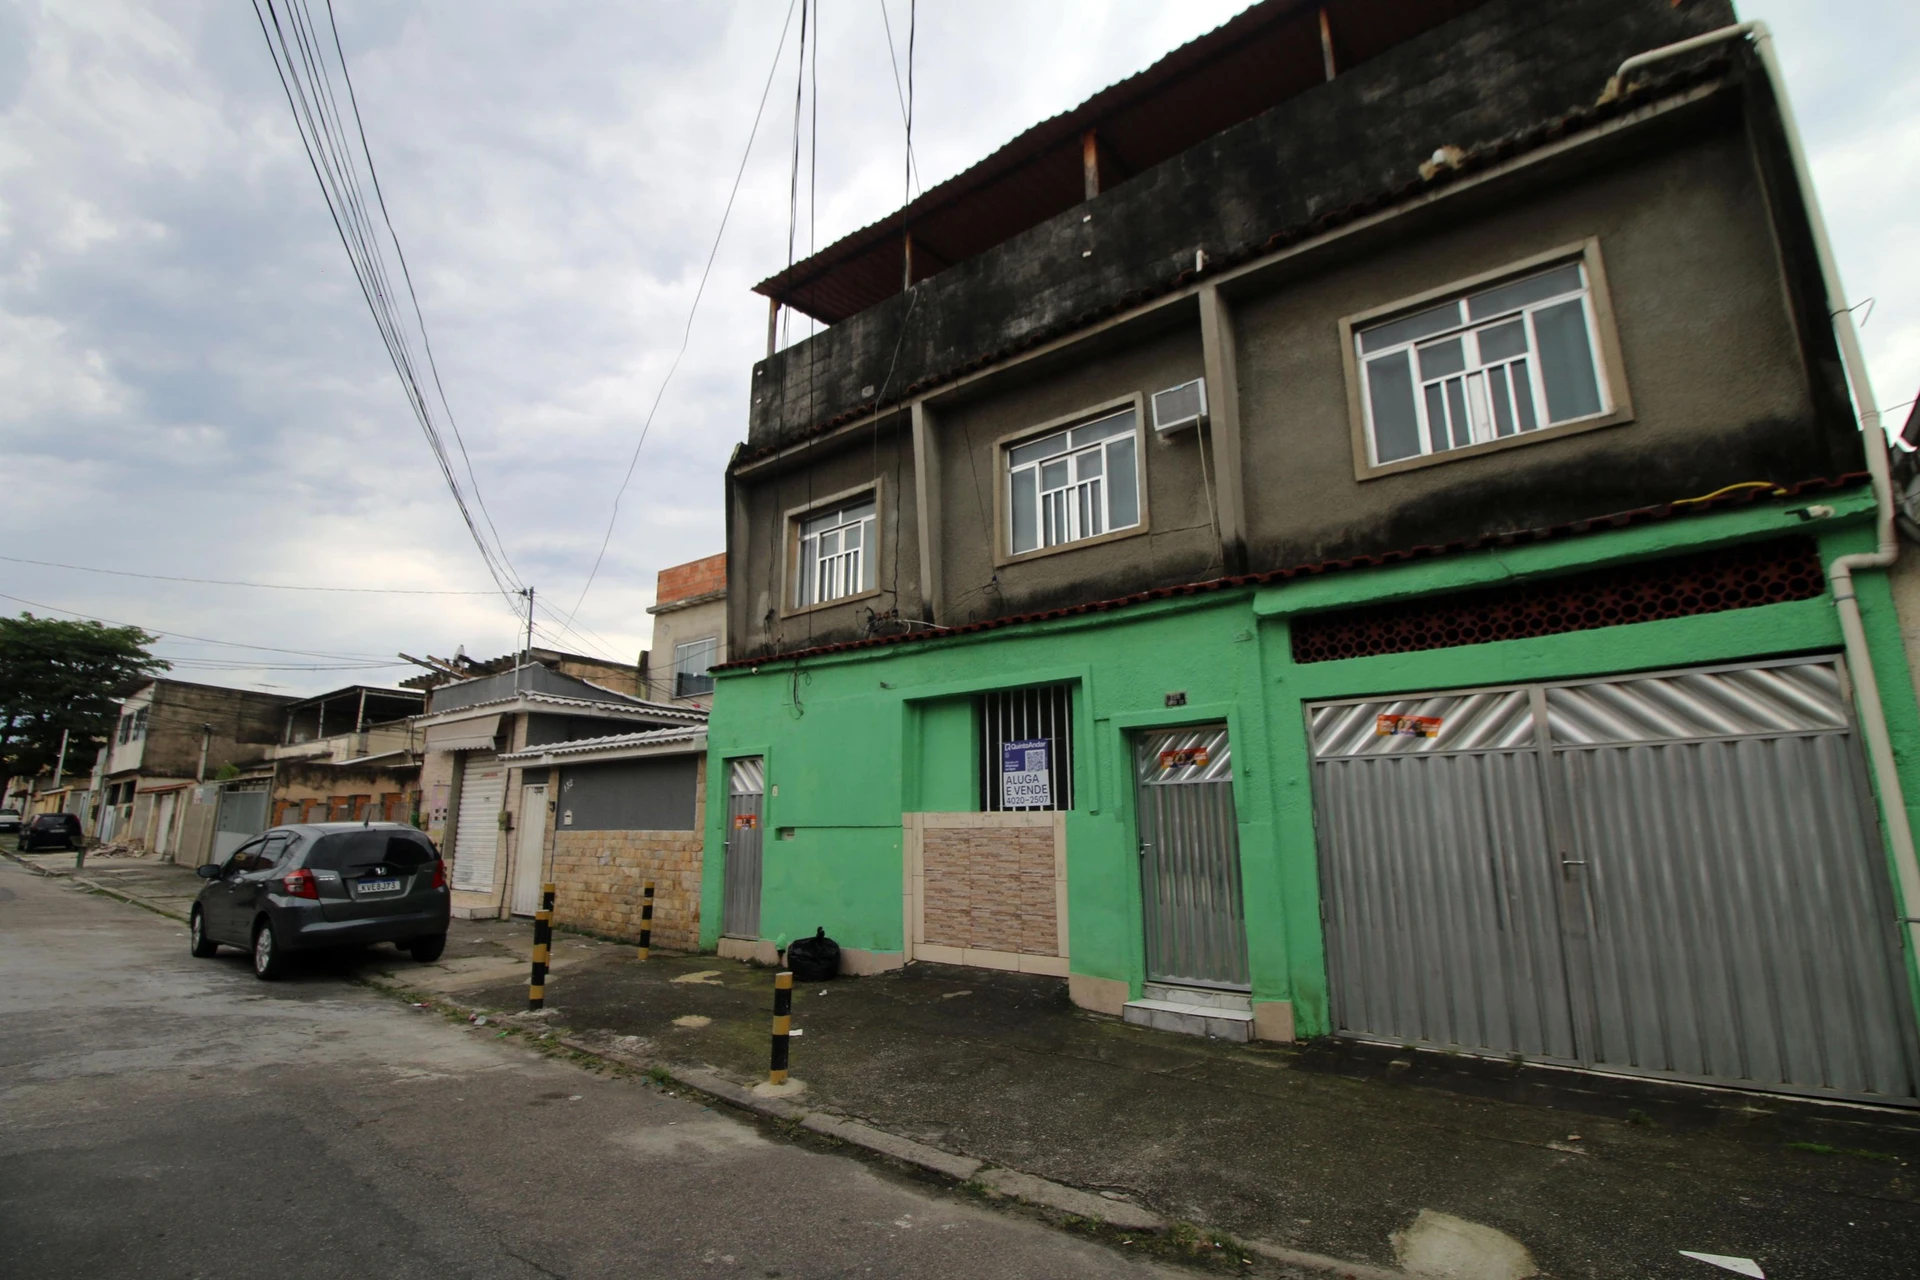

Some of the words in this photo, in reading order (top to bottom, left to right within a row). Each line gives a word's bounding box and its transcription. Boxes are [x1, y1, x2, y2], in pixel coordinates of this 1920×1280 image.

[1010, 741, 1046, 750] QuintoAndar
[1006, 774, 1039, 785] ALUGA
[1006, 786, 1012, 796] E
[1014, 784, 1048, 795] VENDE
[1006, 795, 1048, 804] 4020-2507
